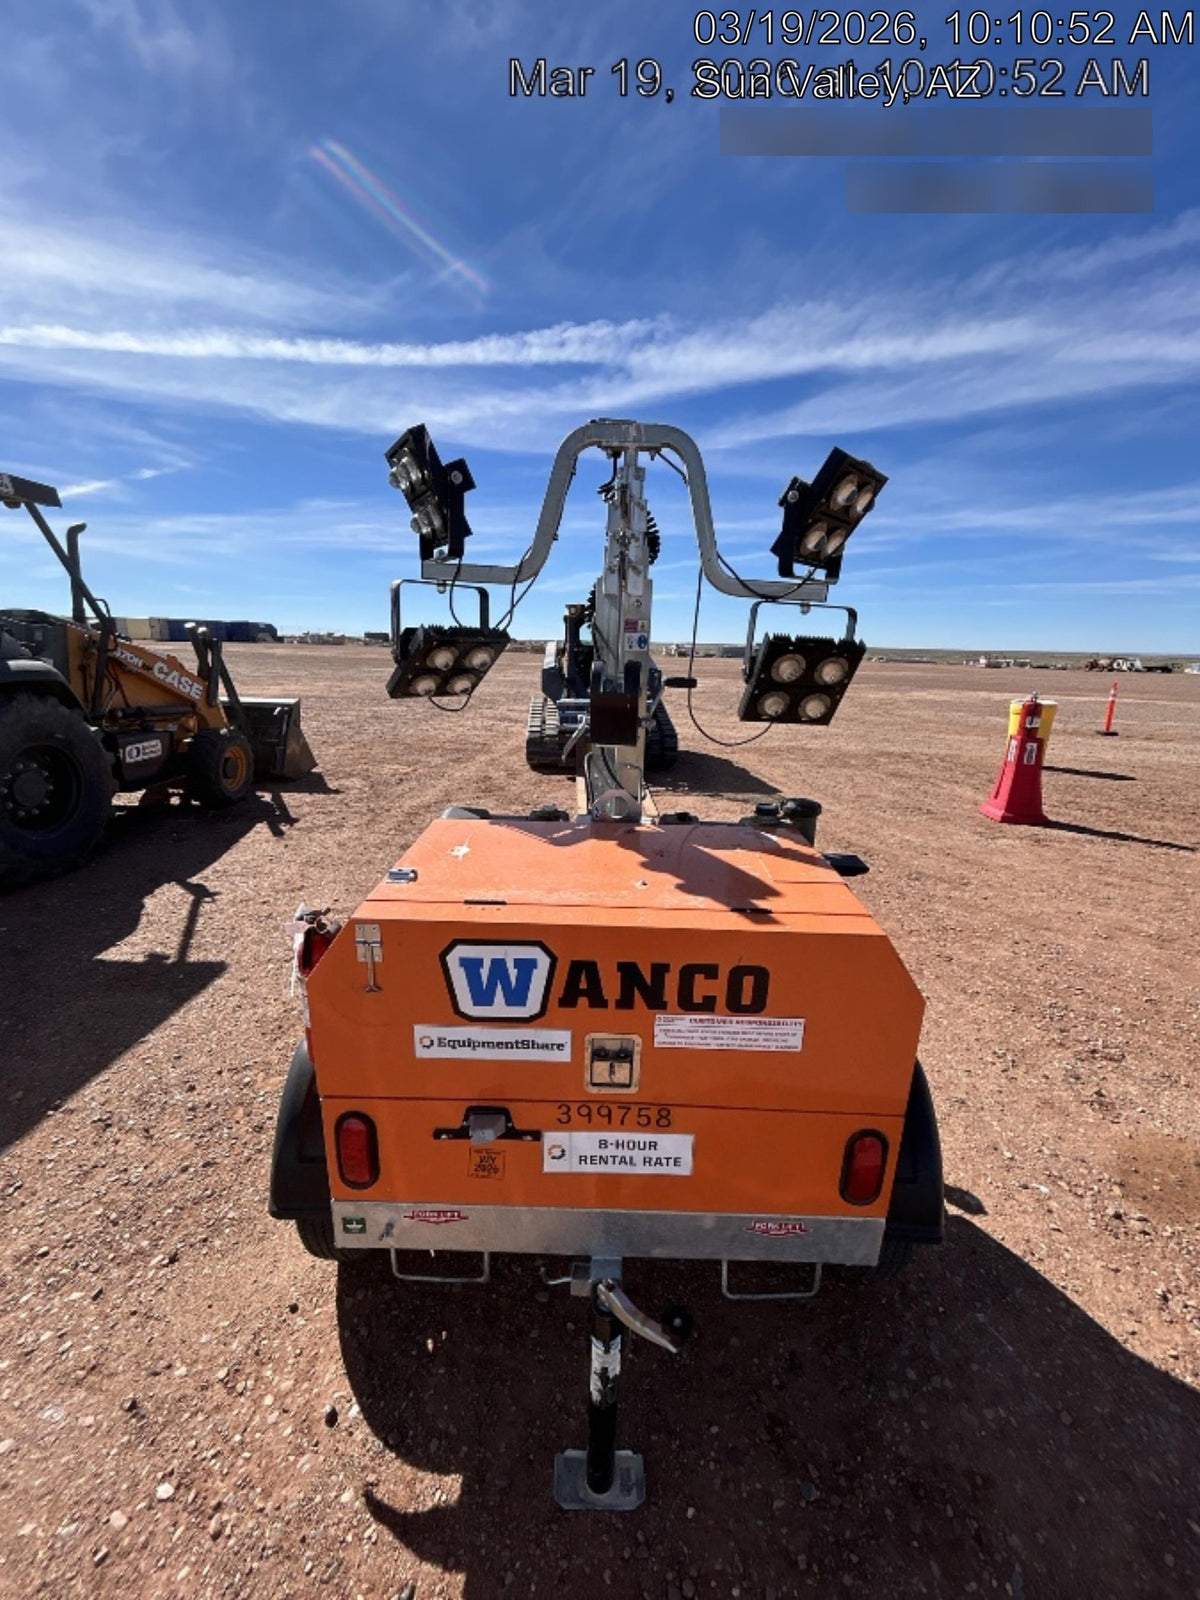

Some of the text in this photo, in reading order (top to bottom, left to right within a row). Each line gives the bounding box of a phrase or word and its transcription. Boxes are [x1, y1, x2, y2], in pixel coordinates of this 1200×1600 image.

[152, 660, 204, 700] CASE
[456, 954, 771, 1014] WANCO
[436, 1036, 566, 1052] EquipmentShare
[556, 1103, 673, 1129] 399758
[598, 1138, 659, 1152] 8-HOUR
[578, 1154, 683, 1168] RENTAL RATE
